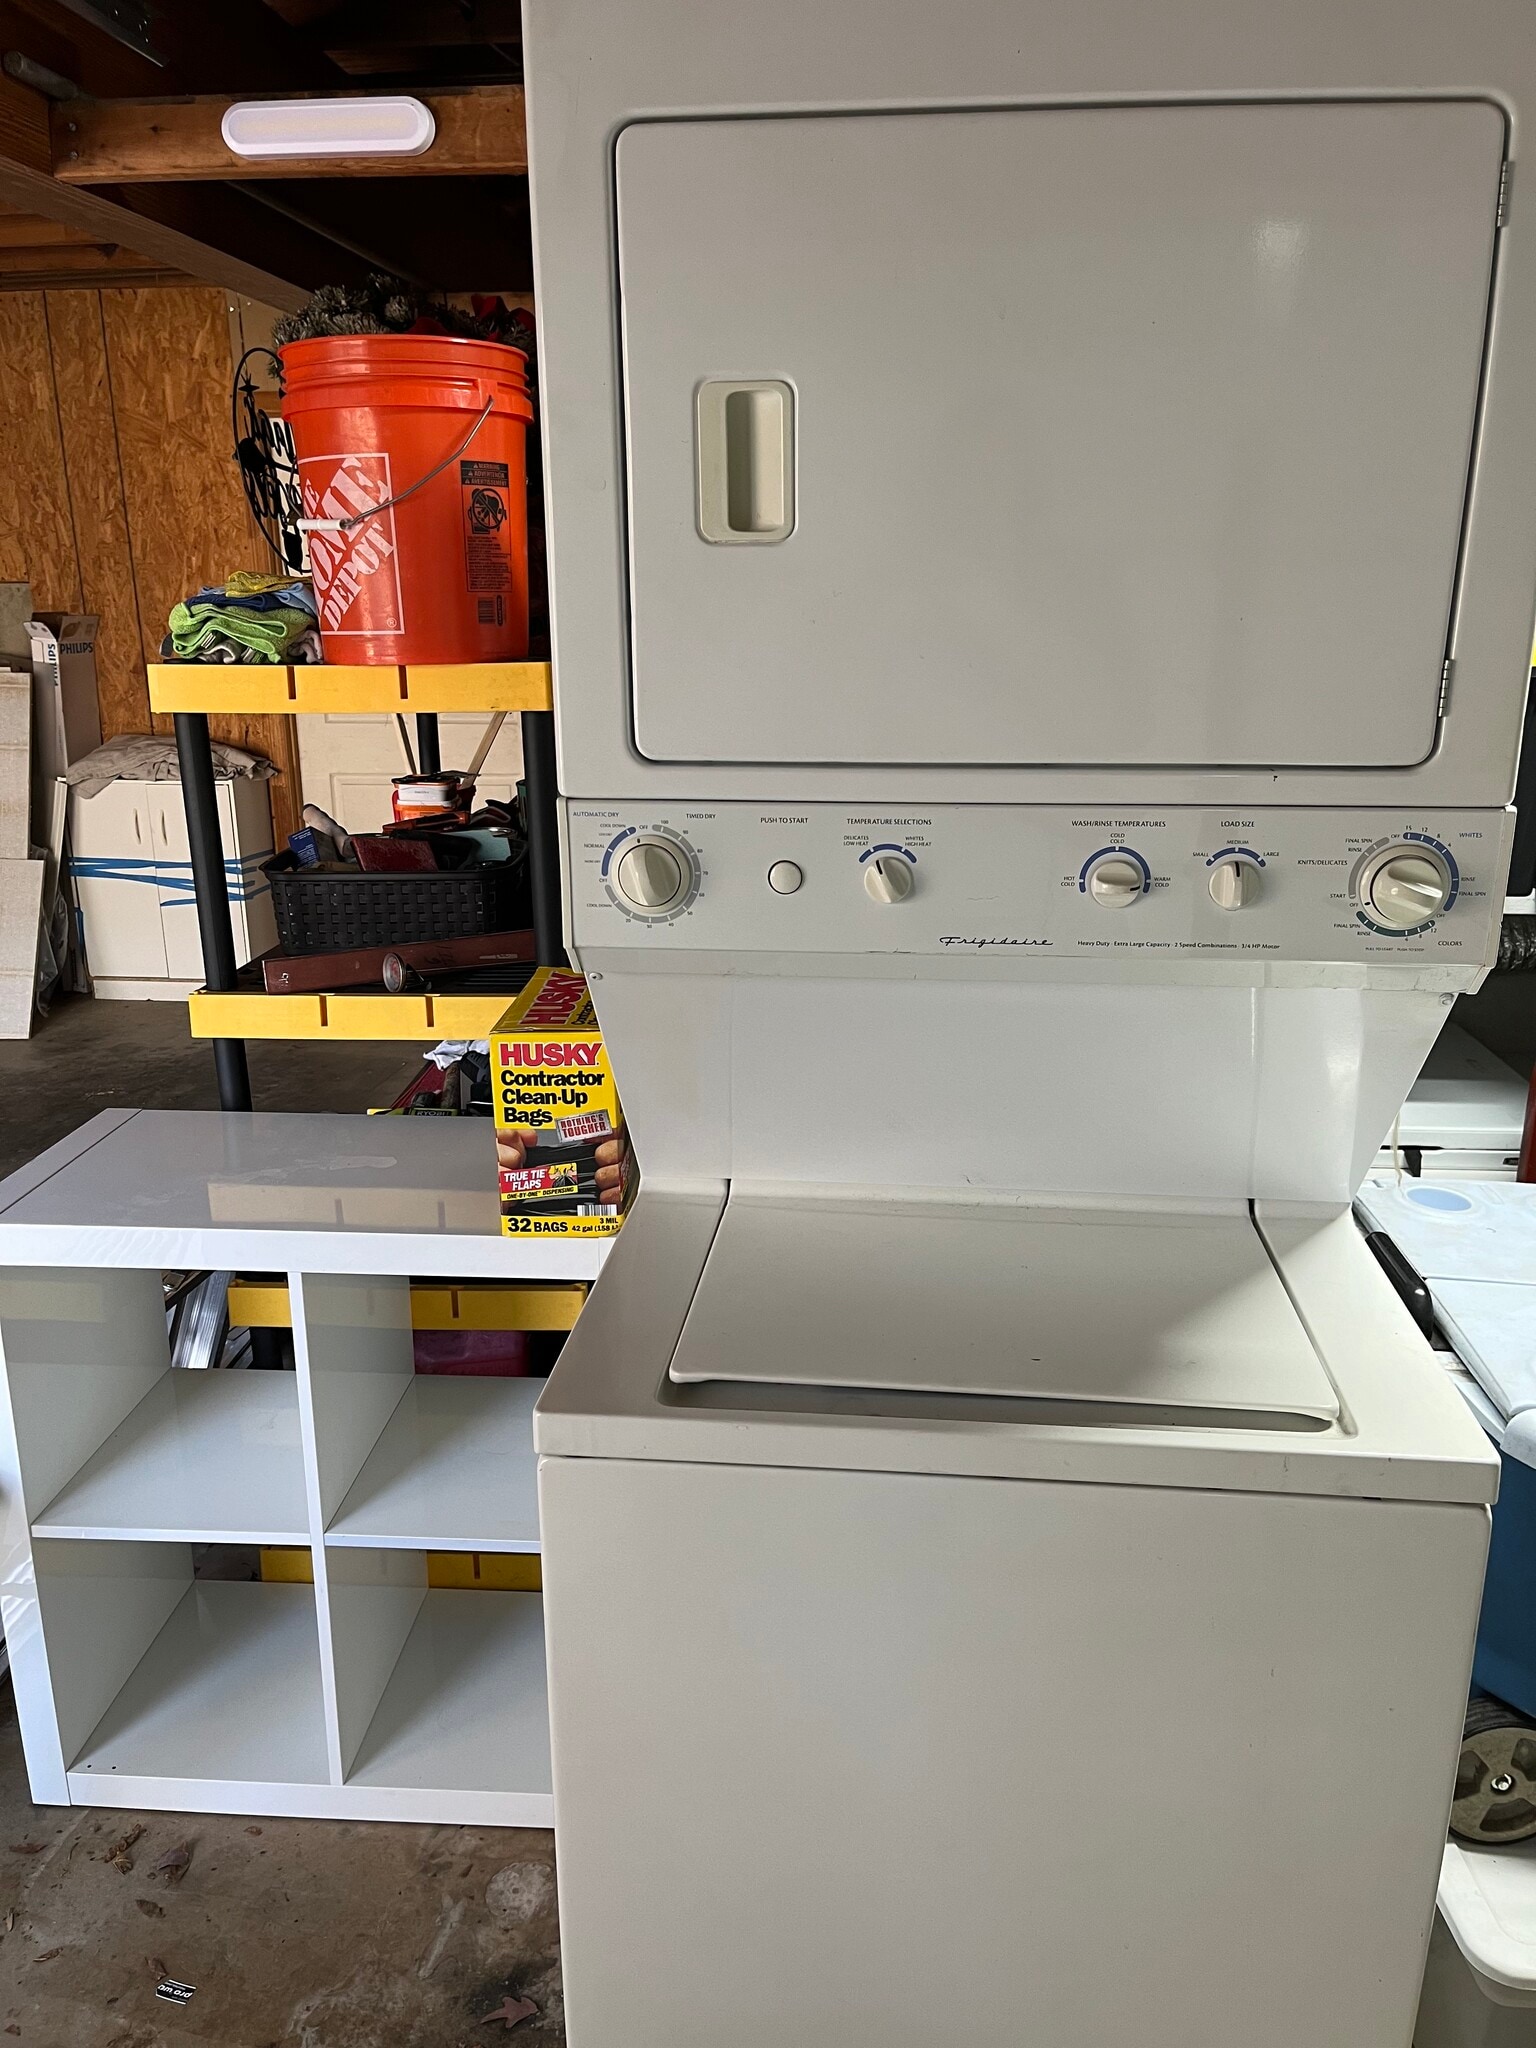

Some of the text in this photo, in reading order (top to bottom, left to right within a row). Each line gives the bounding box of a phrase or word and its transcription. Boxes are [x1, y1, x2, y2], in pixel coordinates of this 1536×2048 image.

[323, 522, 394, 631] DEPOT
[60, 642, 94, 655] PHILIPS
[1071, 820, 1166, 828] WASH/RINSE TEMPERATURES
[939, 936, 1054, 948] Frigidaire
[1077, 940, 1095, 948] Heavy
[1096, 940, 1111, 948] Duty
[1129, 941, 1145, 949] Large
[1145, 941, 1171, 949] Capacity
[519, 970, 588, 1025] HUSKY
[500, 1043, 603, 1067] HUSKY
[501, 1070, 605, 1087] Contractor
[502, 1089, 588, 1108] Clean-Up
[503, 1107, 553, 1127] Bags
[560, 1113, 605, 1130] NOTHING'S
[503, 1170, 546, 1183] TRUE TIE
[512, 1179, 542, 1191] FLAPS
[542, 1186, 575, 1196] DISPENSING
[507, 1218, 569, 1233] 32 BAGS
[582, 1225, 593, 1233] gal
[594, 1225, 611, 1233] (158
